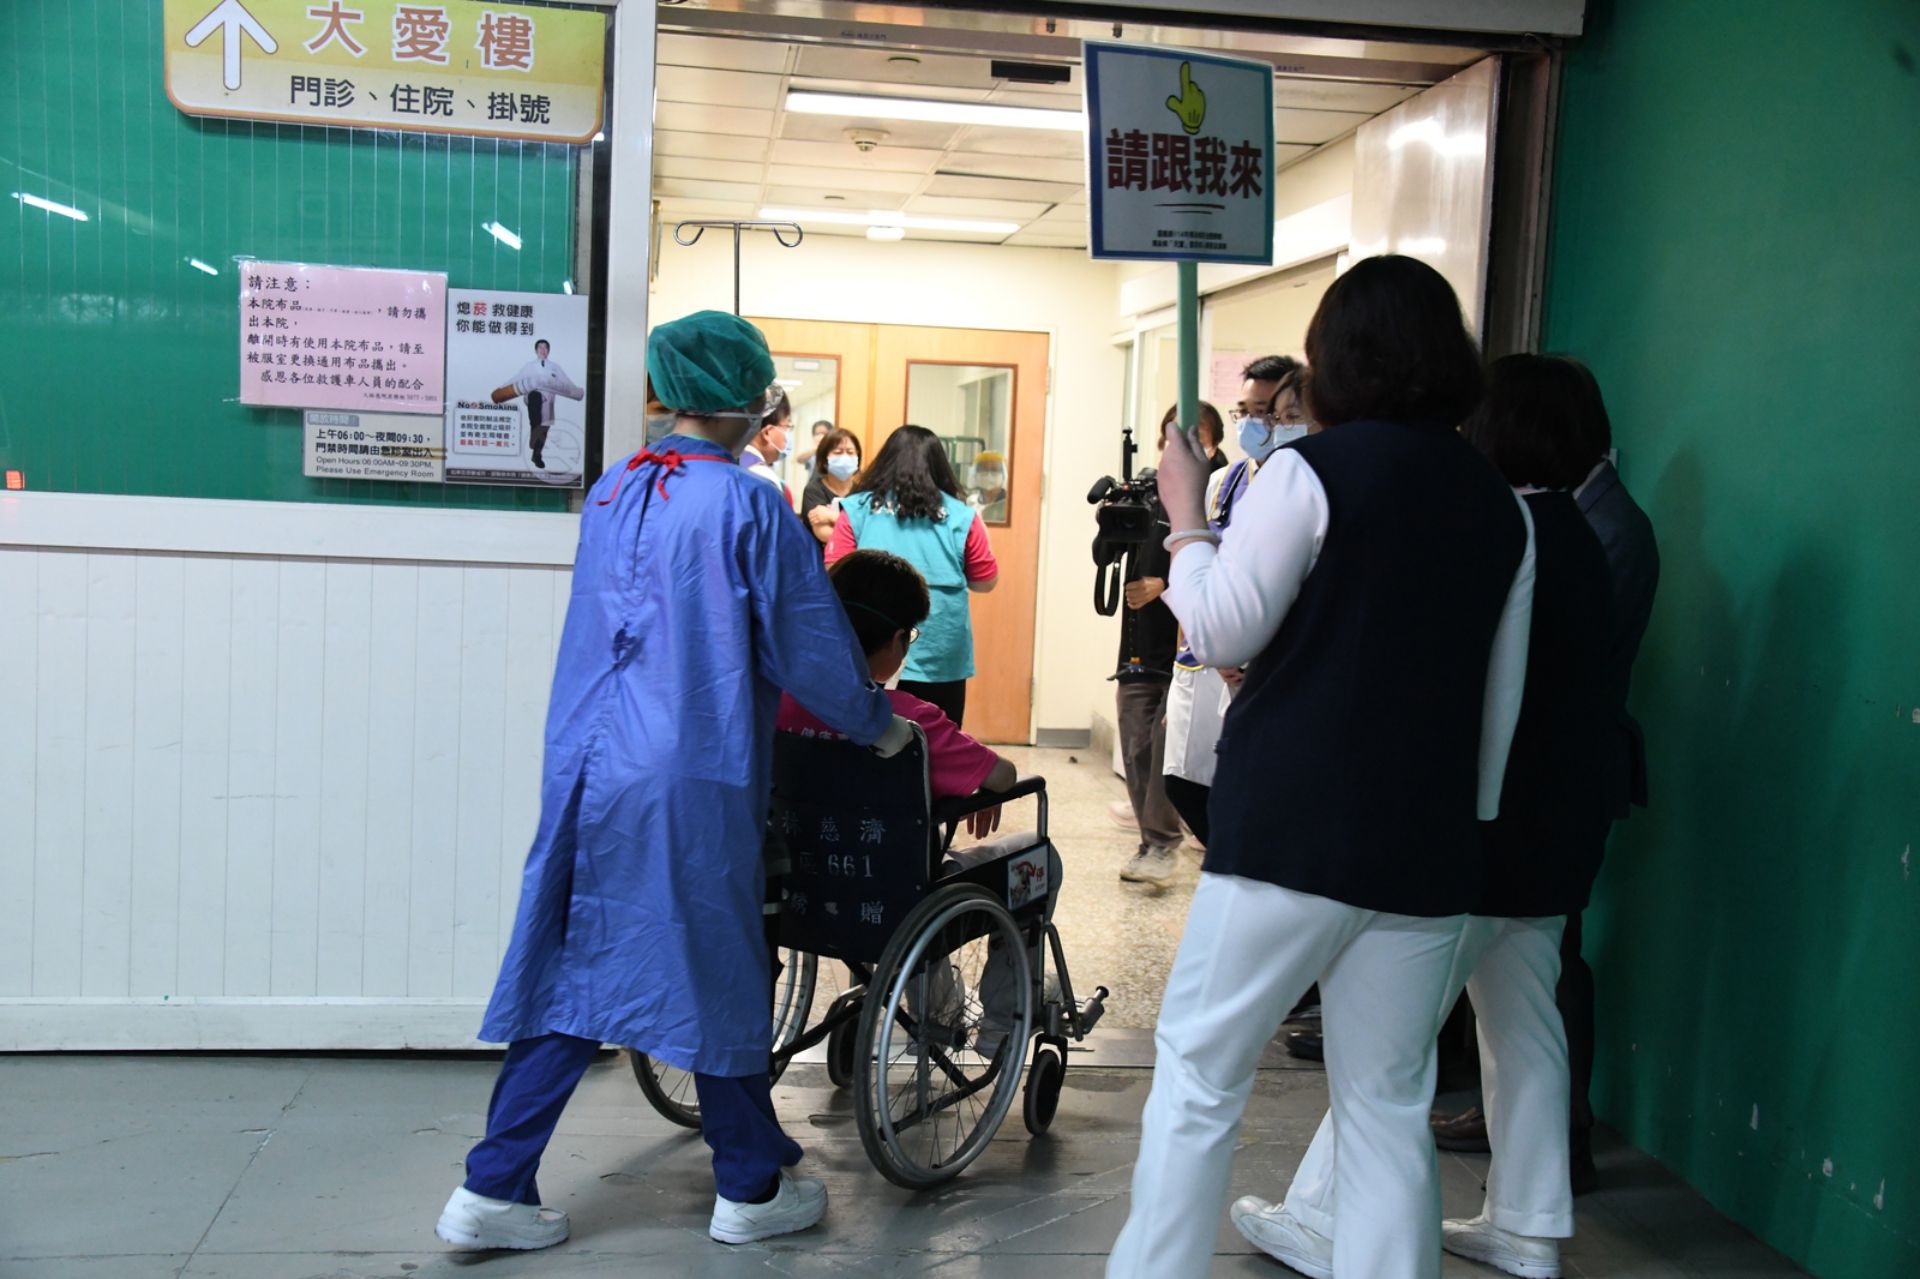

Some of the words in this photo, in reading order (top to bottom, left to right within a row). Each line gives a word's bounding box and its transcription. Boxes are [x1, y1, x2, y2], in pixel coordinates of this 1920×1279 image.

[308, 1, 533, 70] 大愛樓
[290, 76, 550, 125] 門診、住院、掛號
[1106, 128, 1263, 199] 請跟我來
[316, 465, 343, 473] Please
[346, 466, 362, 474] Use
[364, 467, 408, 478] Emergency
[411, 469, 434, 478] Room
[827, 854, 873, 878] 661
